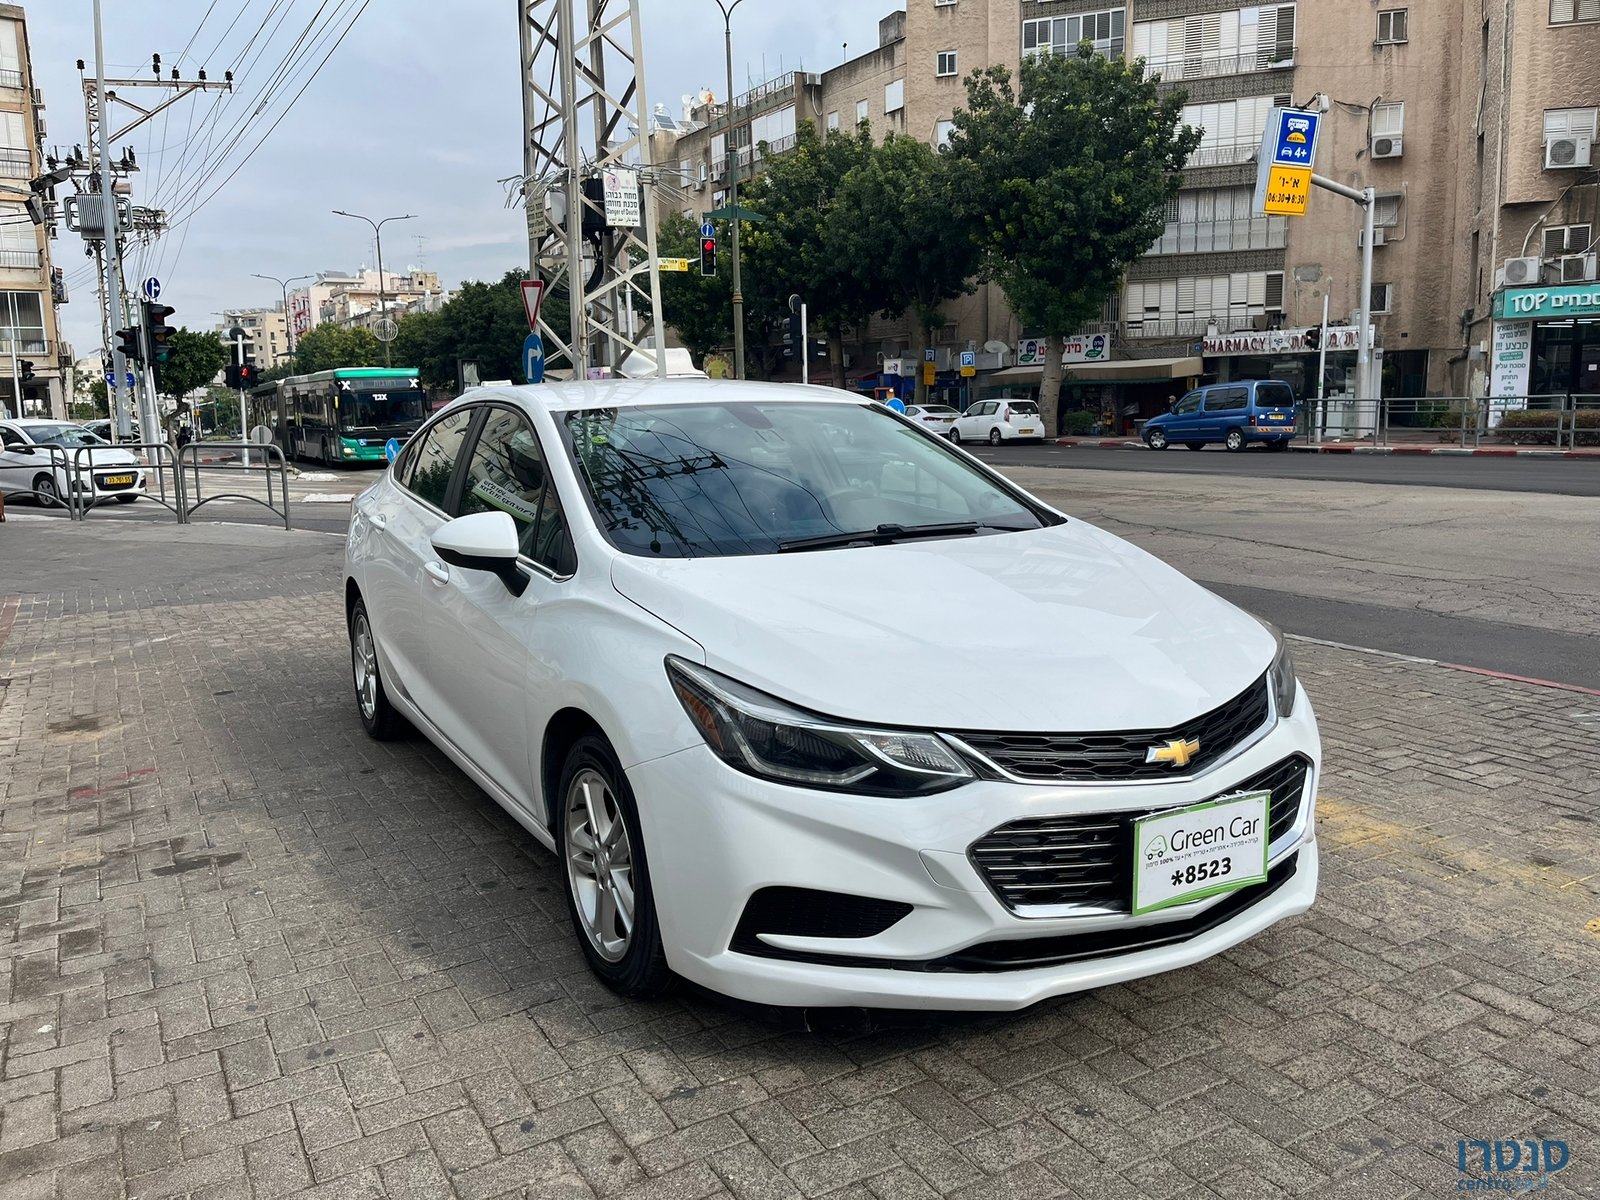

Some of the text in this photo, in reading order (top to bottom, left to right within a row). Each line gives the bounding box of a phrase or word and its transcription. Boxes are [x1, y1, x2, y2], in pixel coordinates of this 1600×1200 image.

[1294, 147, 1307, 158] 4+
[605, 191, 637, 200] מתח גבוה!
[1511, 292, 1548, 313] TOP
[1202, 337, 1267, 353] PHARMACY
[1505, 342, 1528, 350] מבצע
[1170, 817, 1260, 851] Green Car
[1159, 857, 1174, 865] 100%
